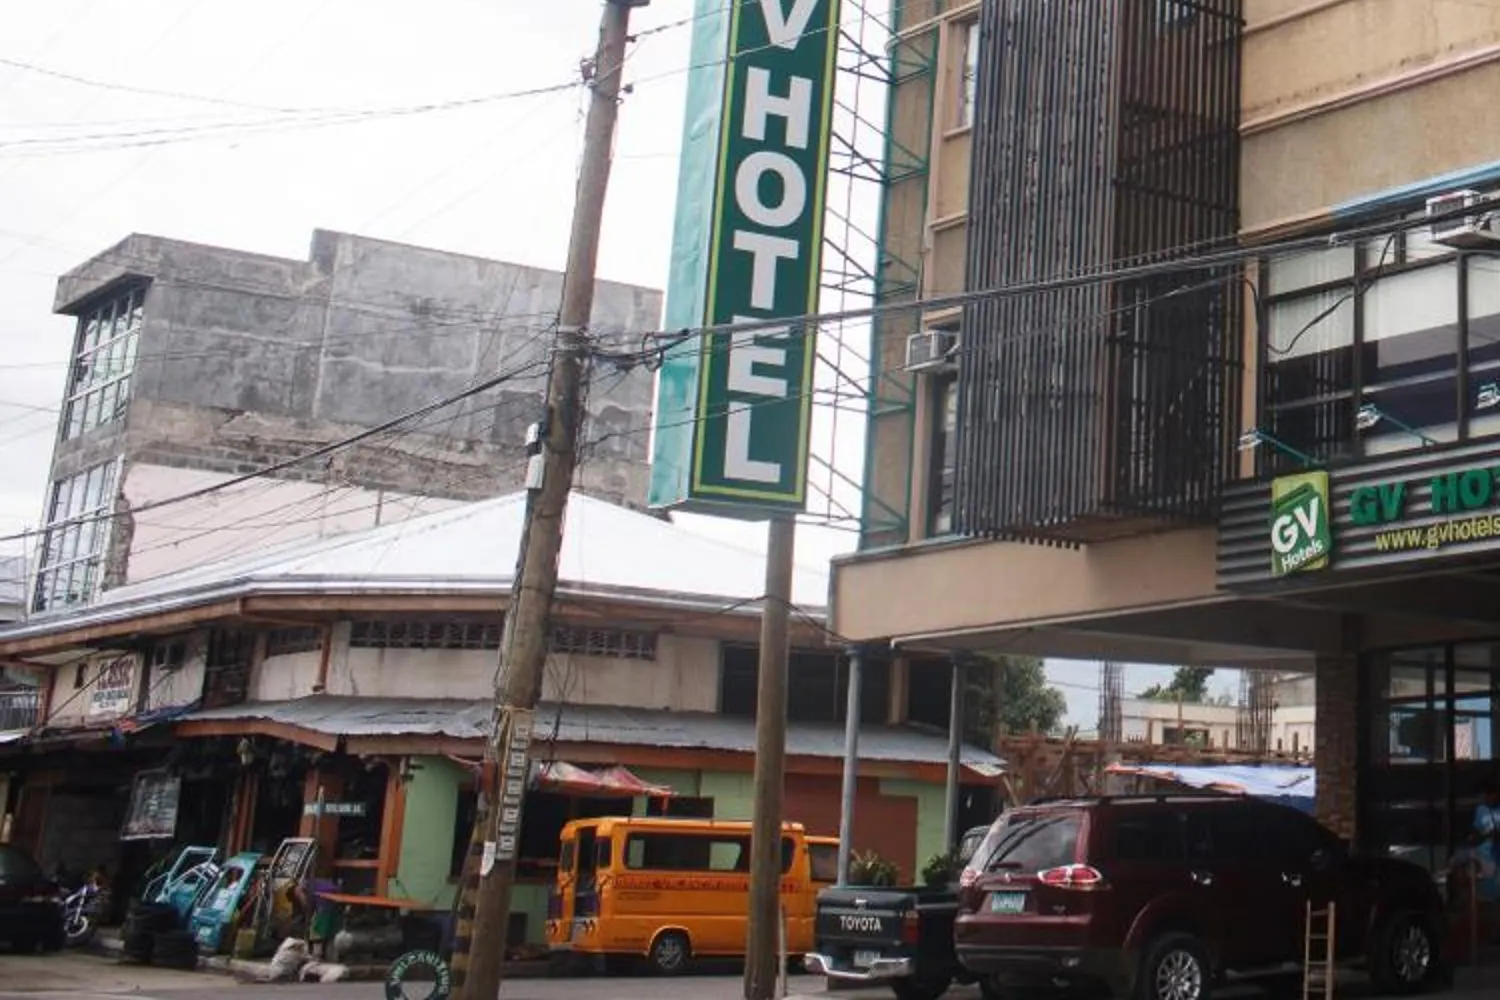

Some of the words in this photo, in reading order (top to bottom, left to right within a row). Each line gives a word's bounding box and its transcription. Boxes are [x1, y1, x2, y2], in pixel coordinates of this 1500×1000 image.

[723, 66, 813, 484] HOTEL
[1271, 495, 1319, 553] GV
[1350, 481, 1406, 527] GV
[1281, 539, 1324, 573] Hotels
[839, 914, 882, 932] TOYOTA
